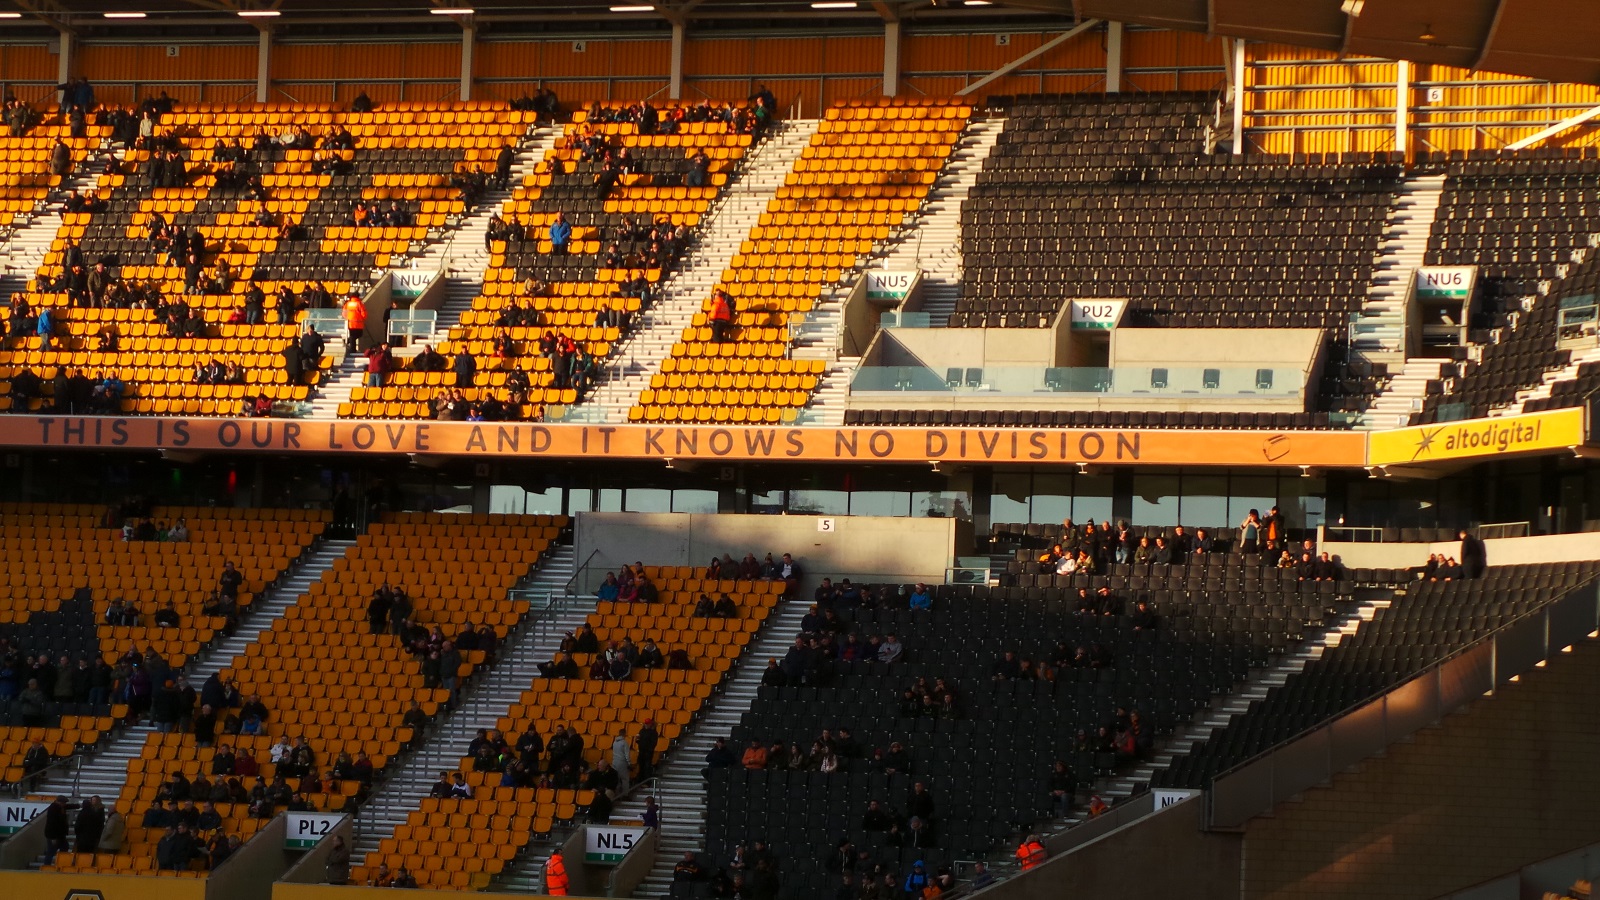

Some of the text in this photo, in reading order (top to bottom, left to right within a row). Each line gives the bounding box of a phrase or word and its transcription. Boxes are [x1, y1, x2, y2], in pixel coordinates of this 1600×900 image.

[999, 35, 1007, 44] 5
[169, 46, 176, 56] 3
[575, 42, 582, 51] 4
[1432, 90, 1438, 100] 6
[400, 274, 430, 287] NU4
[876, 275, 908, 288] NU5
[1427, 272, 1462, 286] NU6
[1082, 305, 1113, 318] PU2
[38, 418, 1140, 459] THIS IS OUR LOVE AND IT KNOWS NO DIVISION
[1446, 419, 1542, 451] altodigital
[822, 519, 830, 530] 5
[298, 819, 331, 836] PL2
[597, 832, 633, 849] NL5
